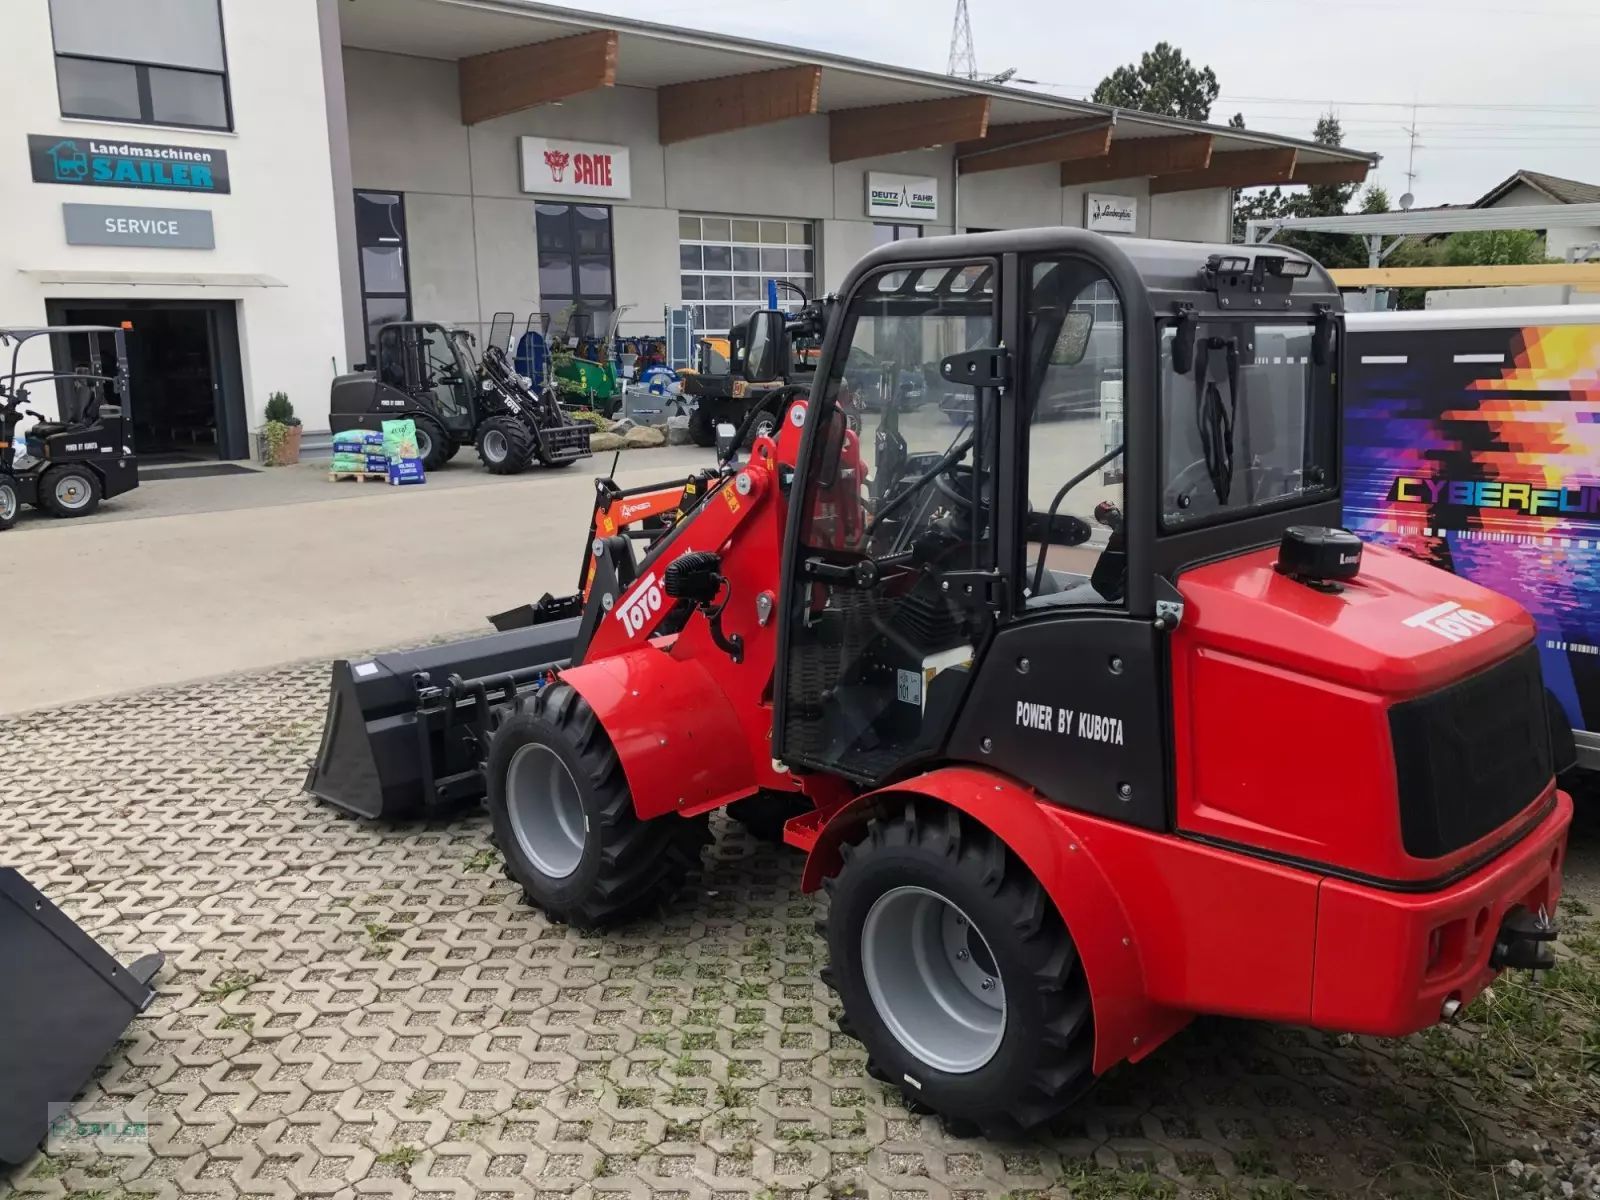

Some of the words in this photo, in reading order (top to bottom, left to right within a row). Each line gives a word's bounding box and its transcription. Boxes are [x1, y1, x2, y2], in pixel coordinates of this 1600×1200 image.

[90, 142, 212, 162] Landmaschinen
[91, 157, 214, 188] SAILER
[574, 153, 612, 187] SAME
[871, 190, 899, 200] DEUTZ
[912, 193, 933, 202] FAHR
[105, 217, 179, 235] SERVICE
[616, 571, 662, 639] TOYO
[1402, 600, 1495, 642] TOYO
[1015, 700, 1053, 732] POWER
[1057, 708, 1074, 735] BY
[1078, 711, 1124, 746] KUBOTA
